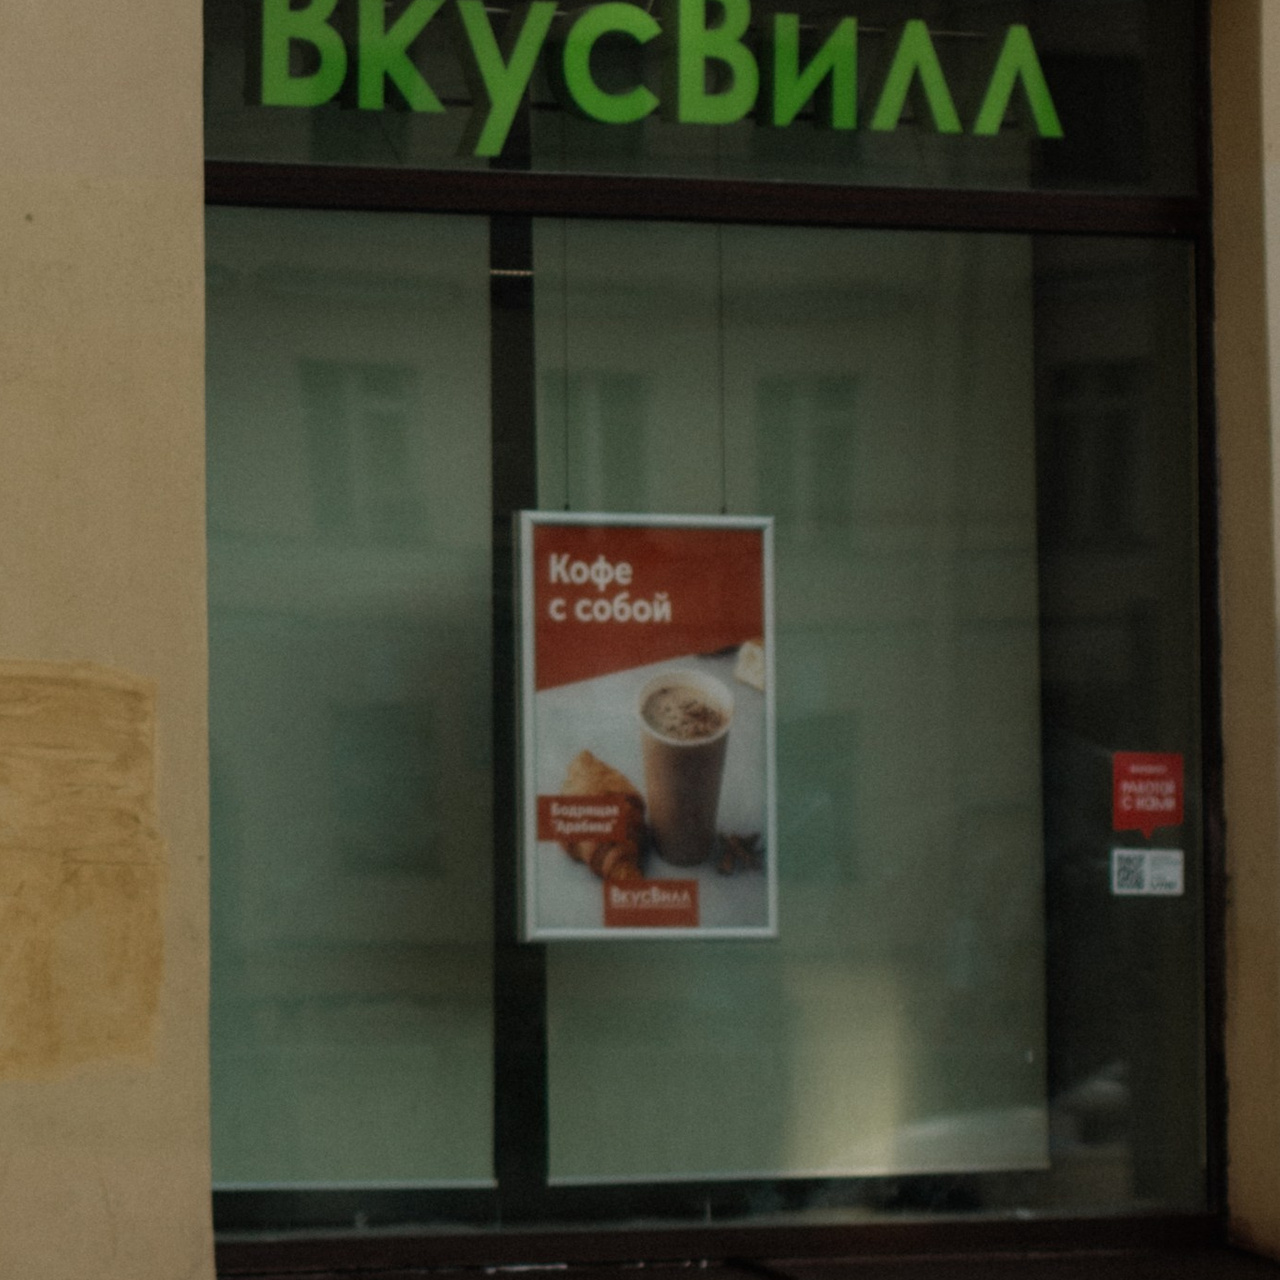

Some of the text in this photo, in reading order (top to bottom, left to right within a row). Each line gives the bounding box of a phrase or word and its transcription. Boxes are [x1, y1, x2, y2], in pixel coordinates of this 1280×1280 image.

[548, 552, 634, 592] Кофе
[549, 591, 673, 623] с собой
